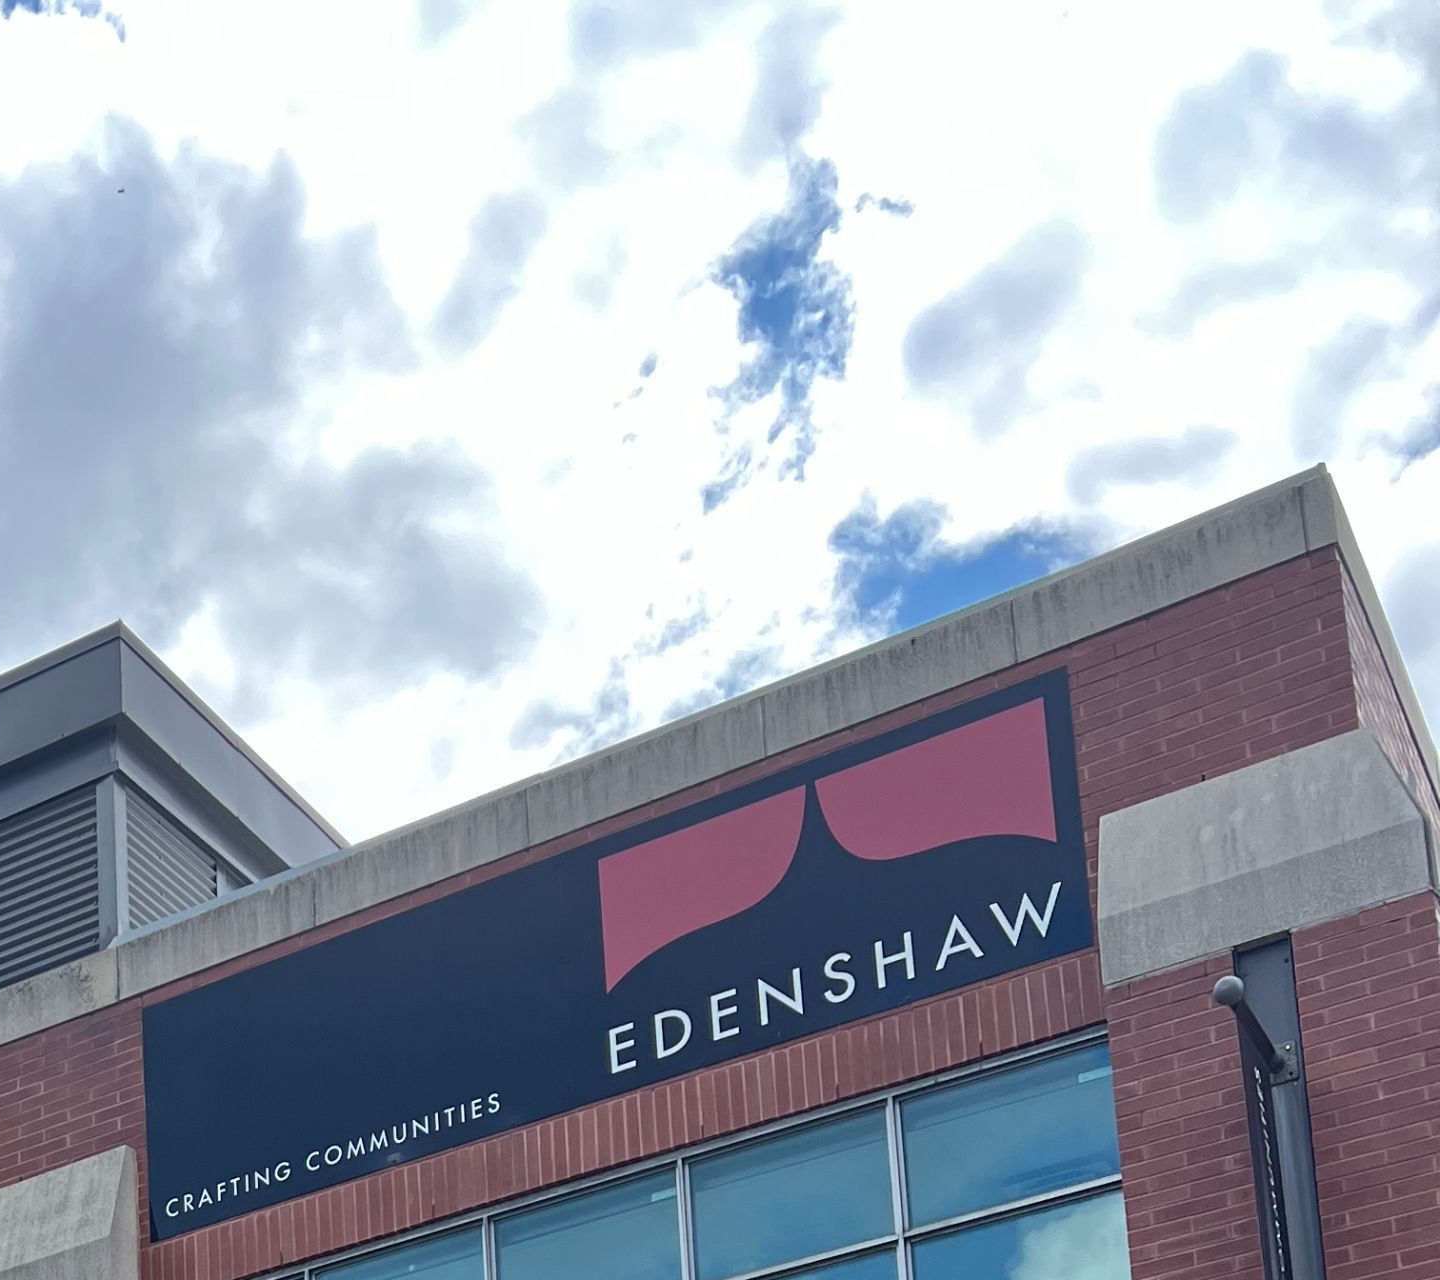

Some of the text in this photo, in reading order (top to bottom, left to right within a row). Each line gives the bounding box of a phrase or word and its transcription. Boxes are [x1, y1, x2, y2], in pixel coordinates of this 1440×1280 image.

[608, 882, 1062, 1074] EDENSHAW
[165, 1093, 502, 1217] CRAFTING COMMUNITIES
